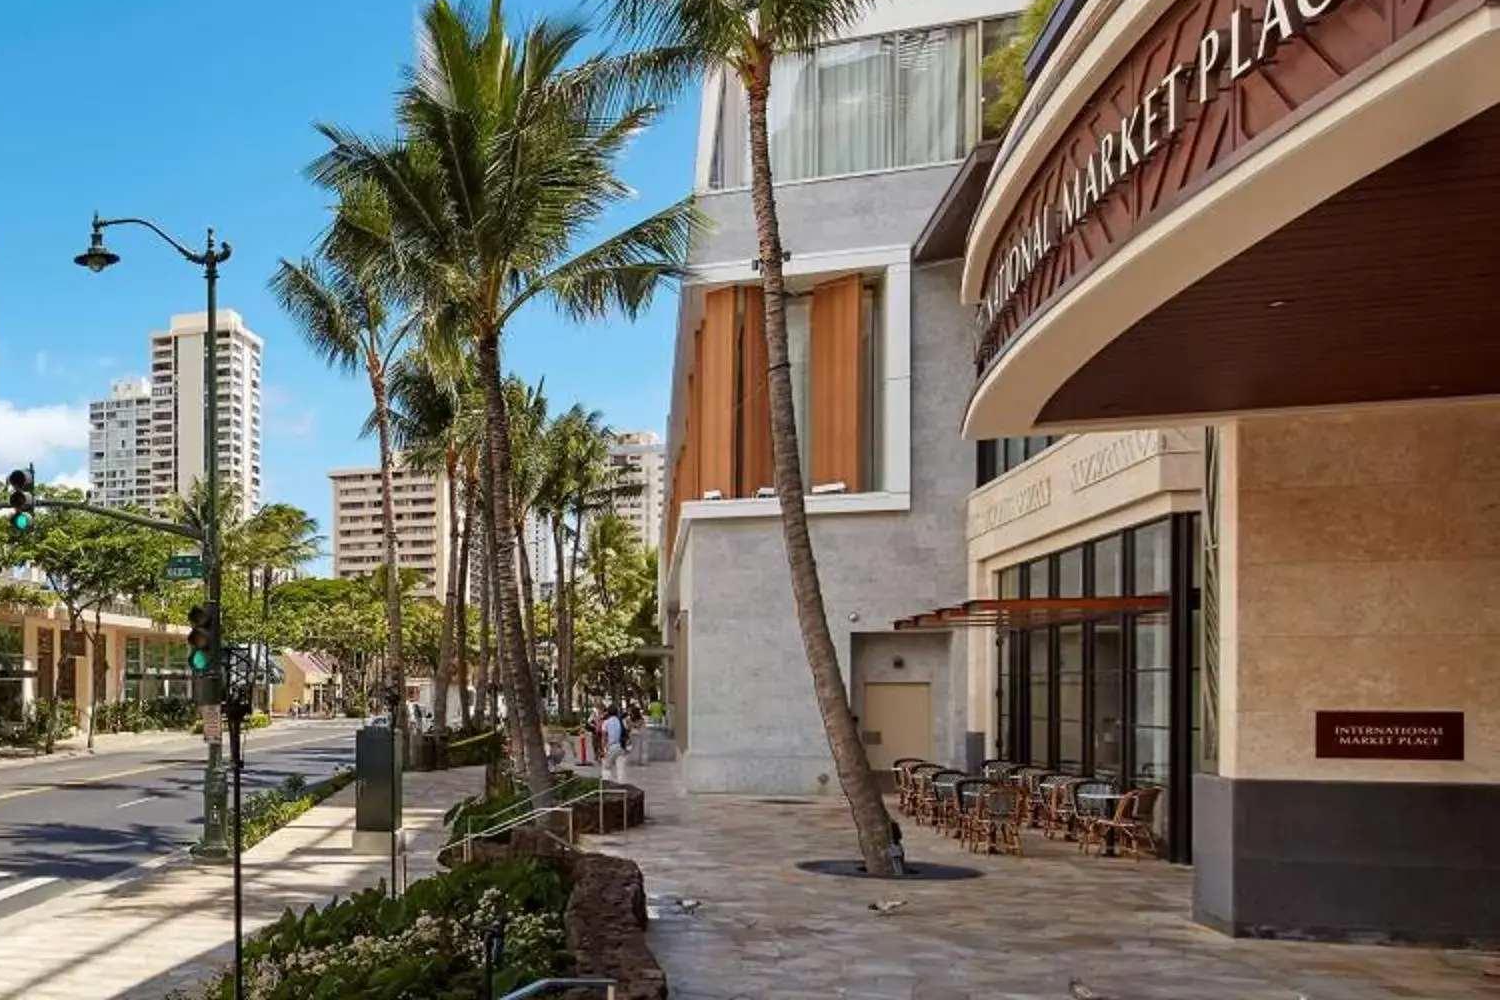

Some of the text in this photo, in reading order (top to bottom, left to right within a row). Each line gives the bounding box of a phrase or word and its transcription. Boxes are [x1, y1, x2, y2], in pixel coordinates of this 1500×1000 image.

[1061, 64, 1184, 236] MARKET
[1334, 726, 1444, 735] INTERNATIONAL
[1338, 736, 1440, 746] MARKET PLACE
